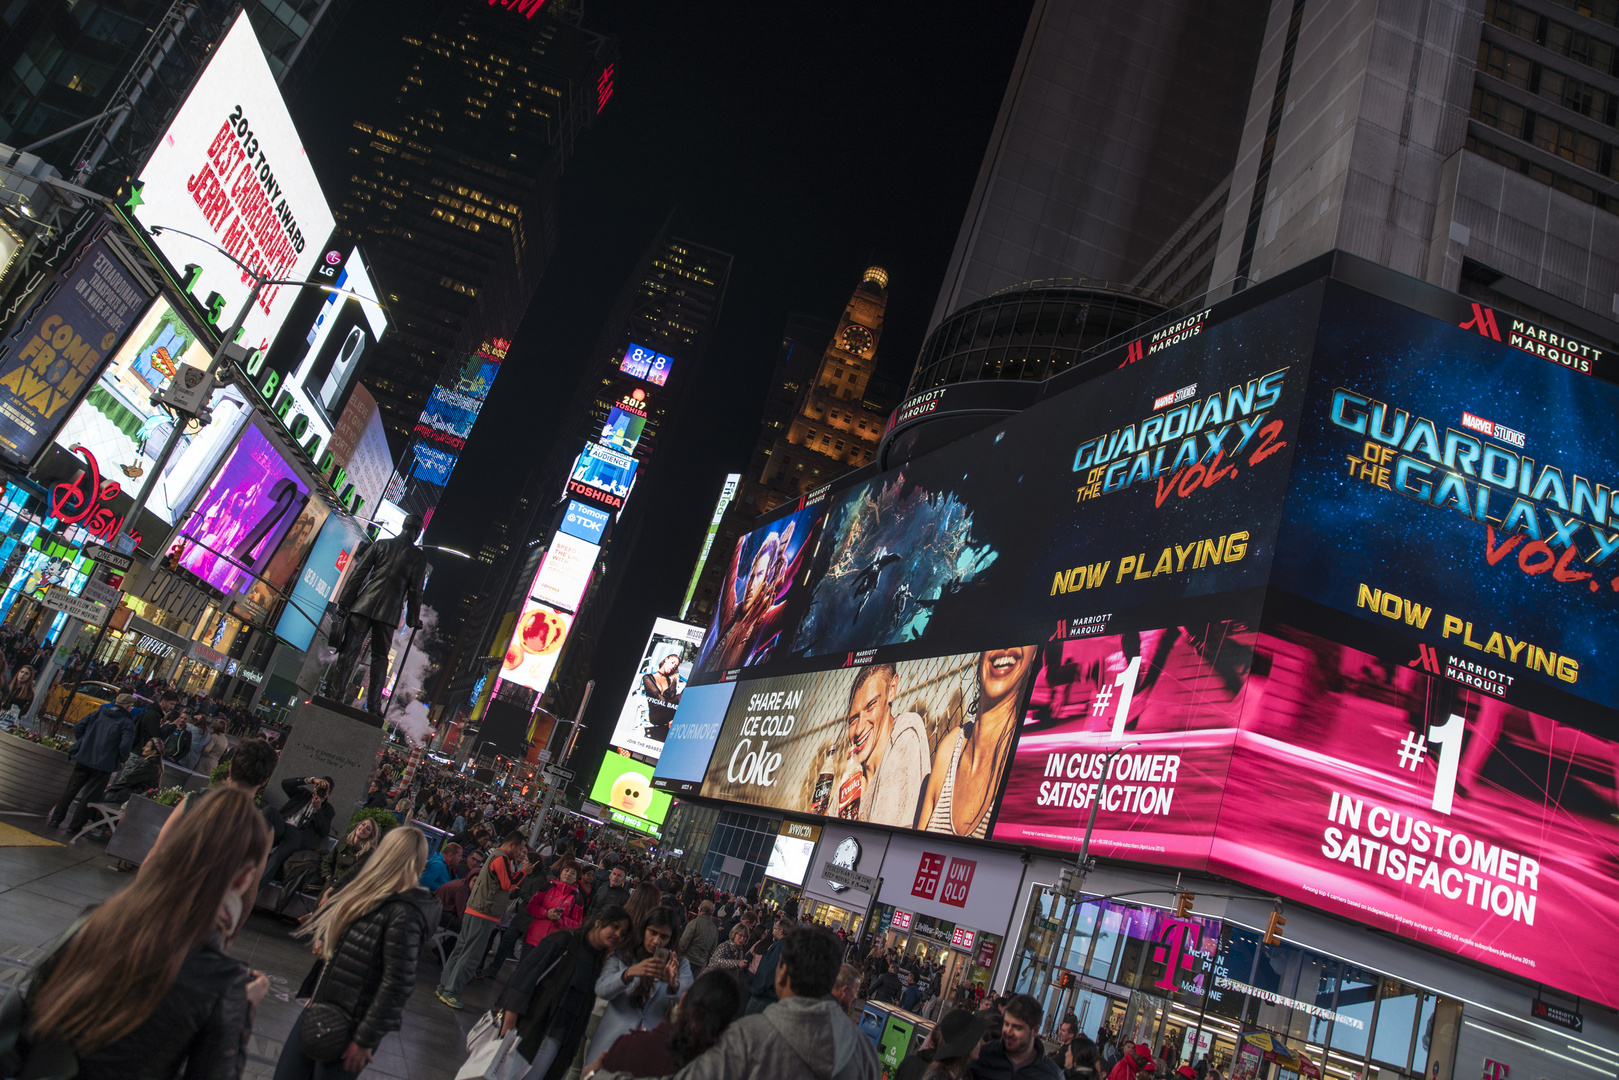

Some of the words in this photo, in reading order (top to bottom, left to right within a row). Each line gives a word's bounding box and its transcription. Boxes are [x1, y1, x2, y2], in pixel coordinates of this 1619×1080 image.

[206, 120, 245, 185] BEST
[229, 105, 259, 158] 2013
[255, 151, 282, 203] TONY
[275, 199, 305, 254] AWARD
[187, 162, 234, 234] JERRY
[319, 264, 335, 277] LG
[75, 278, 88, 294] ON
[82, 287, 92, 299] A
[87, 290, 106, 314] WAVE
[101, 306, 113, 319] OF
[89, 272, 122, 310] TRANSPORTS
[117, 302, 128, 317] US
[1152, 308, 1212, 343] MARRIOTT
[40, 314, 100, 377] COME
[1148, 325, 1201, 356] MARQUIS
[1510, 333, 1590, 373] MARQUIS
[1512, 319, 1603, 362] MARRIOTT
[18, 334, 85, 400] FROM
[0, 364, 70, 419] AWAY
[623, 395, 647, 411] 2017
[901, 388, 947, 411] MARRIOTT
[1154, 392, 1175, 411] MARVEL
[1174, 383, 1198, 403] STUDIOS
[615, 401, 648, 419] TOSHIBA
[898, 401, 937, 422] MARQUIS
[1072, 366, 1291, 473] GUARDIANS
[1462, 411, 1494, 438] MARVEL
[1493, 423, 1526, 449] STUDIOS
[593, 450, 629, 468] AUDIENCE
[1102, 411, 1270, 496] GALAXY
[1155, 449, 1239, 509] VOL.
[1249, 419, 1287, 467] 2
[1362, 440, 1398, 467] OF
[1086, 465, 1107, 485] OF
[1346, 454, 1393, 491] THE
[569, 480, 622, 509] TOSHIBA
[808, 484, 832, 499] MARRIOTT
[1076, 481, 1102, 503] THE
[576, 515, 603, 533] TDK
[1394, 454, 1619, 568] GALAXY
[97, 550, 112, 561] ONE
[112, 554, 129, 568] WAY
[1050, 560, 1111, 596] NOW
[1115, 530, 1250, 584] PLAYING
[1486, 524, 1599, 593] VOL.
[48, 590, 78, 604] PEDESTRIAN
[76, 597, 90, 609] FLOW
[89, 603, 103, 615] ZONE
[141, 566, 211, 627] FOREVER
[68, 605, 81, 615] KEEP
[80, 609, 100, 622] MOVING
[1072, 613, 1113, 627] MARRIOTT
[1069, 624, 1105, 636] MARQUIS
[1356, 582, 1433, 631] NOW
[1442, 612, 1580, 684] PLAYING
[135, 634, 167, 656] FOREVER
[161, 646, 174, 658] 21
[1446, 667, 1505, 696] MARQUIS
[1448, 654, 1515, 686] MARRIOTT
[747, 691, 785, 712] SHARE
[781, 689, 804, 710] AN
[1092, 655, 1142, 742] #1
[669, 722, 720, 740] #YOURMOVE
[739, 716, 762, 737] ICE
[759, 715, 795, 737] COLD
[1043, 753, 1067, 778] IN
[1066, 753, 1181, 783] CUSTOMER
[1396, 713, 1466, 816] #1
[1037, 780, 1175, 816] SATISFACTION
[1327, 791, 1364, 830] IN
[1367, 806, 1540, 892] CUSTOMER
[824, 871, 835, 879] KEEP
[826, 863, 851, 877] PEDESTRIAN
[921, 856, 942, 876] ユニ
[950, 863, 971, 882] UNI
[1321, 827, 1538, 927] SATISFACTION
[944, 882, 967, 903] QLO
[1301, 883, 1319, 895] Among
[1318, 888, 1327, 897] top
[1329, 893, 1347, 904] carriers
[1346, 898, 1361, 908] based
[1367, 906, 1395, 920] independent
[1402, 917, 1414, 927] party
[1451, 933, 1459, 941] US
[1458, 936, 1474, 947] mobile
[1474, 941, 1500, 956] subscribers
[1181, 979, 1206, 996] Mobile
[1208, 990, 1223, 1002] NE
[1547, 1006, 1575, 1020] MARRIOTT
[1547, 1012, 1572, 1025] MARQUIS
[884, 1053, 898, 1066] PAPER
